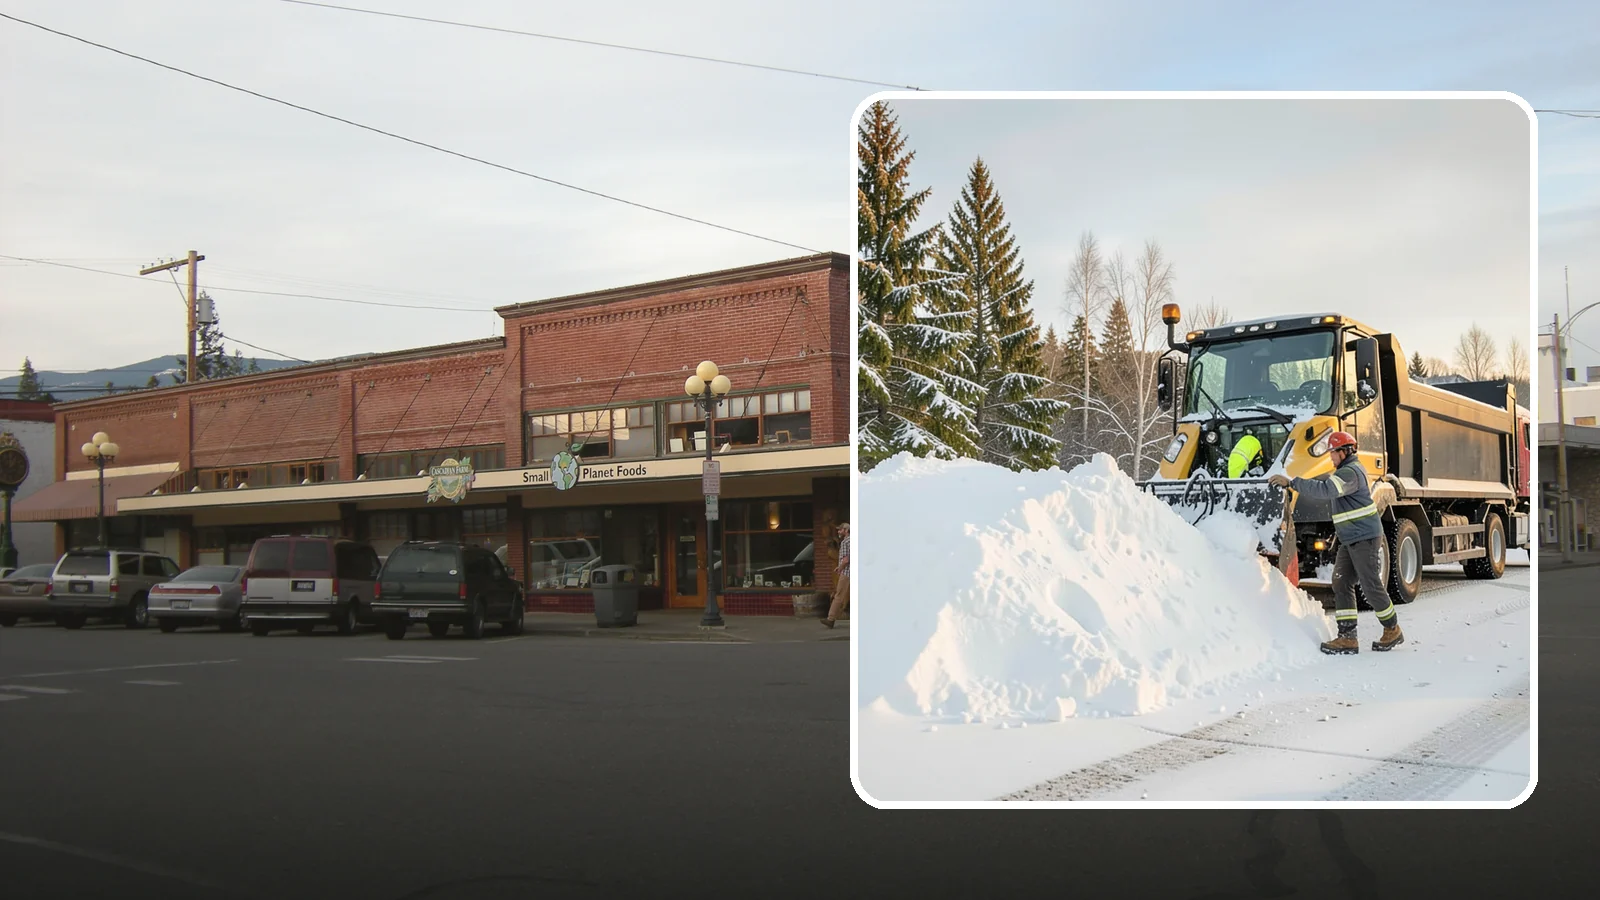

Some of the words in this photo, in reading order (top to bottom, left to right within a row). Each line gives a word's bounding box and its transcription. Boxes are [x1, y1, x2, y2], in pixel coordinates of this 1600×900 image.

[523, 471, 549, 483] Small
[582, 466, 614, 479] Planet
[616, 465, 647, 477] Foods
